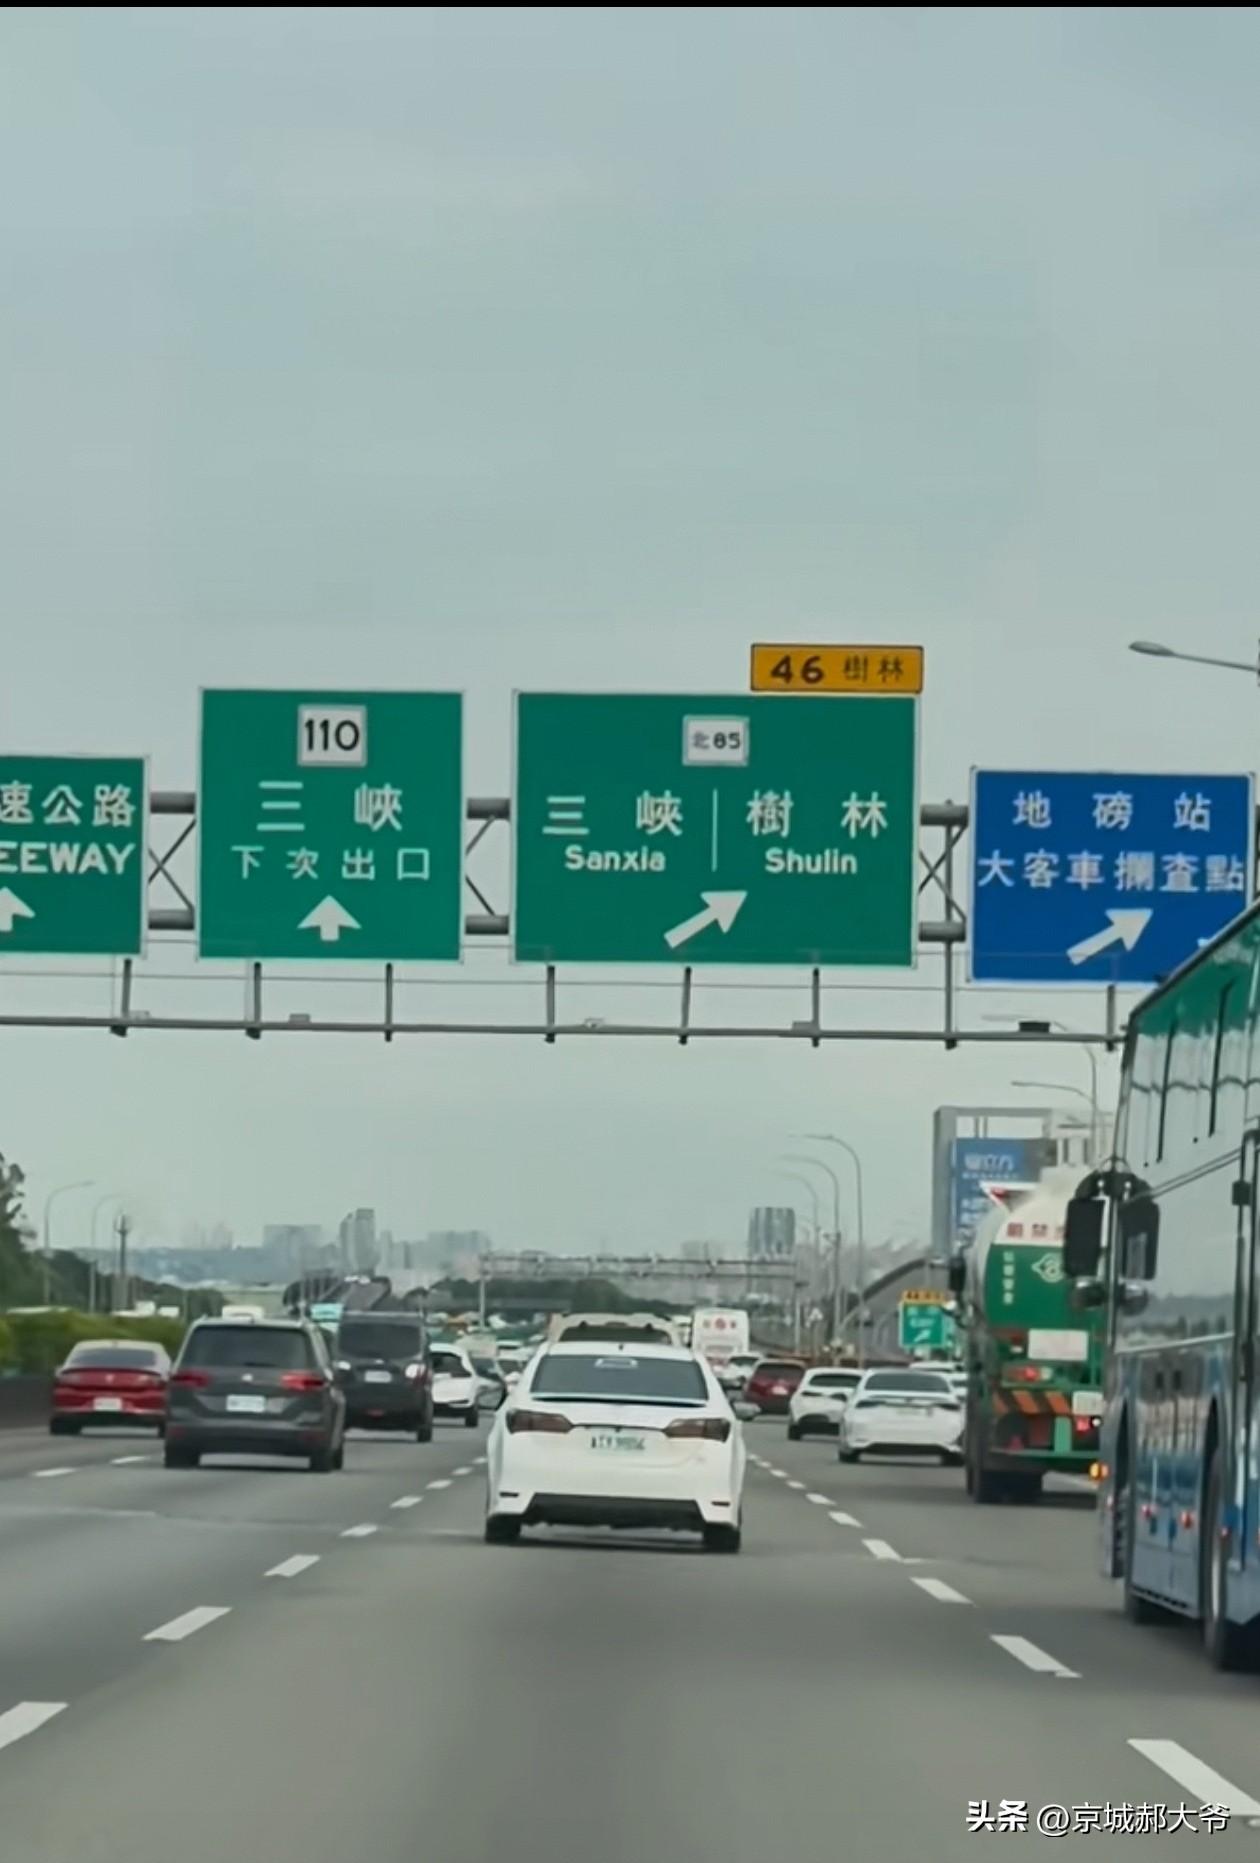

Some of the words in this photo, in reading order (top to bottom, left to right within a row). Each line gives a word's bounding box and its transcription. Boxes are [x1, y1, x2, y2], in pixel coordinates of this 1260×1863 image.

[770, 655, 824, 684] 46
[843, 656, 904, 684] 樹林
[304, 719, 361, 751] 110
[257, 780, 403, 832] 三峽
[542, 790, 683, 837] 三峽
[746, 789, 888, 838] 樹林
[1011, 790, 1212, 832] 地磅站
[231, 845, 430, 880] 下次出口
[564, 844, 666, 872] Sanxia
[764, 847, 858, 875] Shulin
